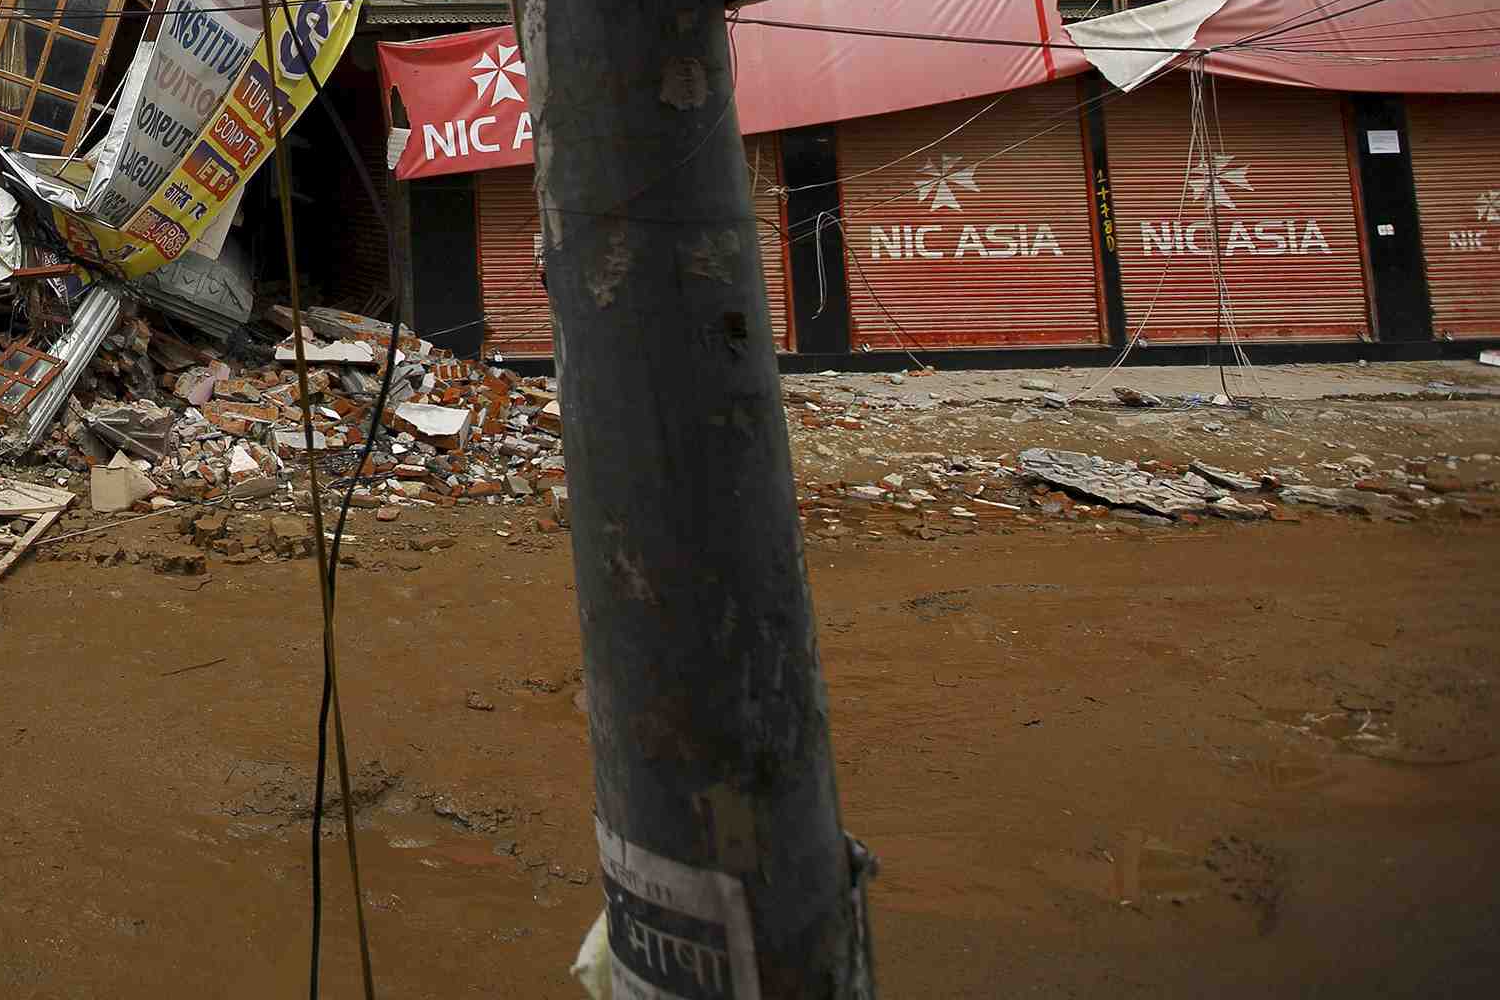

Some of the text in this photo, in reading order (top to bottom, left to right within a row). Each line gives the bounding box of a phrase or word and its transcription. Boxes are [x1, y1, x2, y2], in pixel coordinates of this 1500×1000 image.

[422, 115, 501, 162] NIC
[870, 224, 1063, 259] NIC ASIA
[1140, 217, 1332, 256] NIC ASIA
[1449, 231, 1487, 250] NIC
